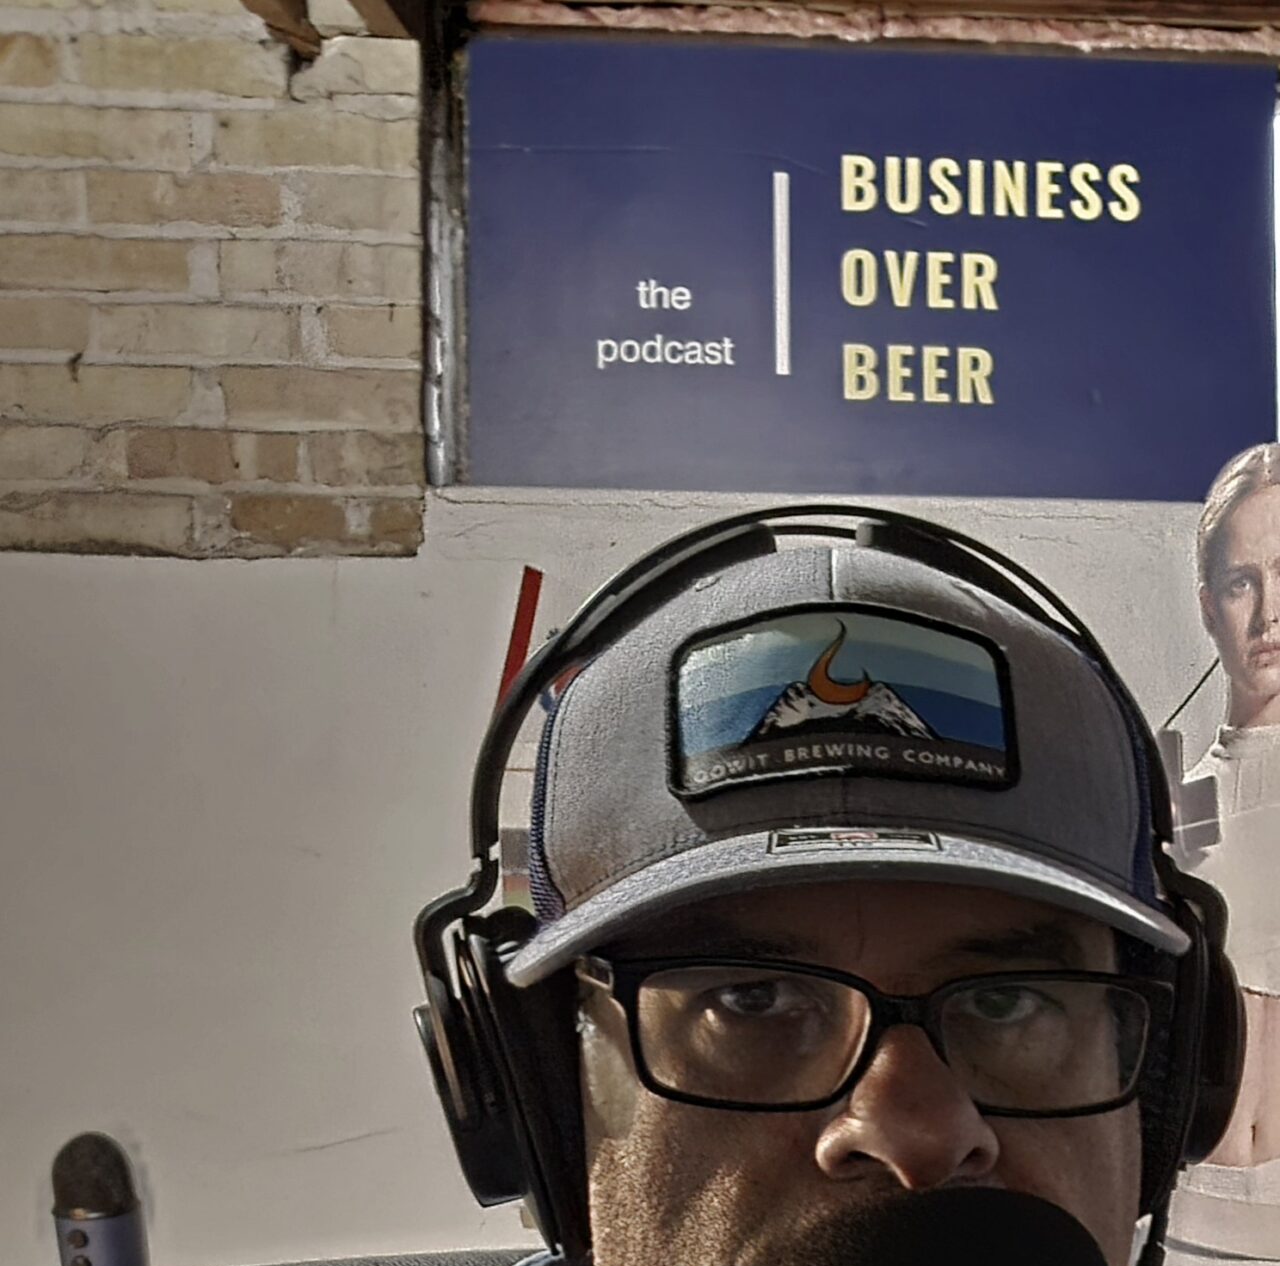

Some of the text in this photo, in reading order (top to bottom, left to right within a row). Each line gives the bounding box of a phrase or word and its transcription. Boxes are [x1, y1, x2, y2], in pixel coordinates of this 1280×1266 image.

[840, 154, 1142, 222] BUSINESS
[637, 280, 692, 310] the
[841, 248, 999, 311] OVER
[597, 334, 736, 369] podcast
[842, 343, 995, 404] BEER
[783, 743, 890, 763] BREWING
[902, 749, 1006, 777] COMPANY
